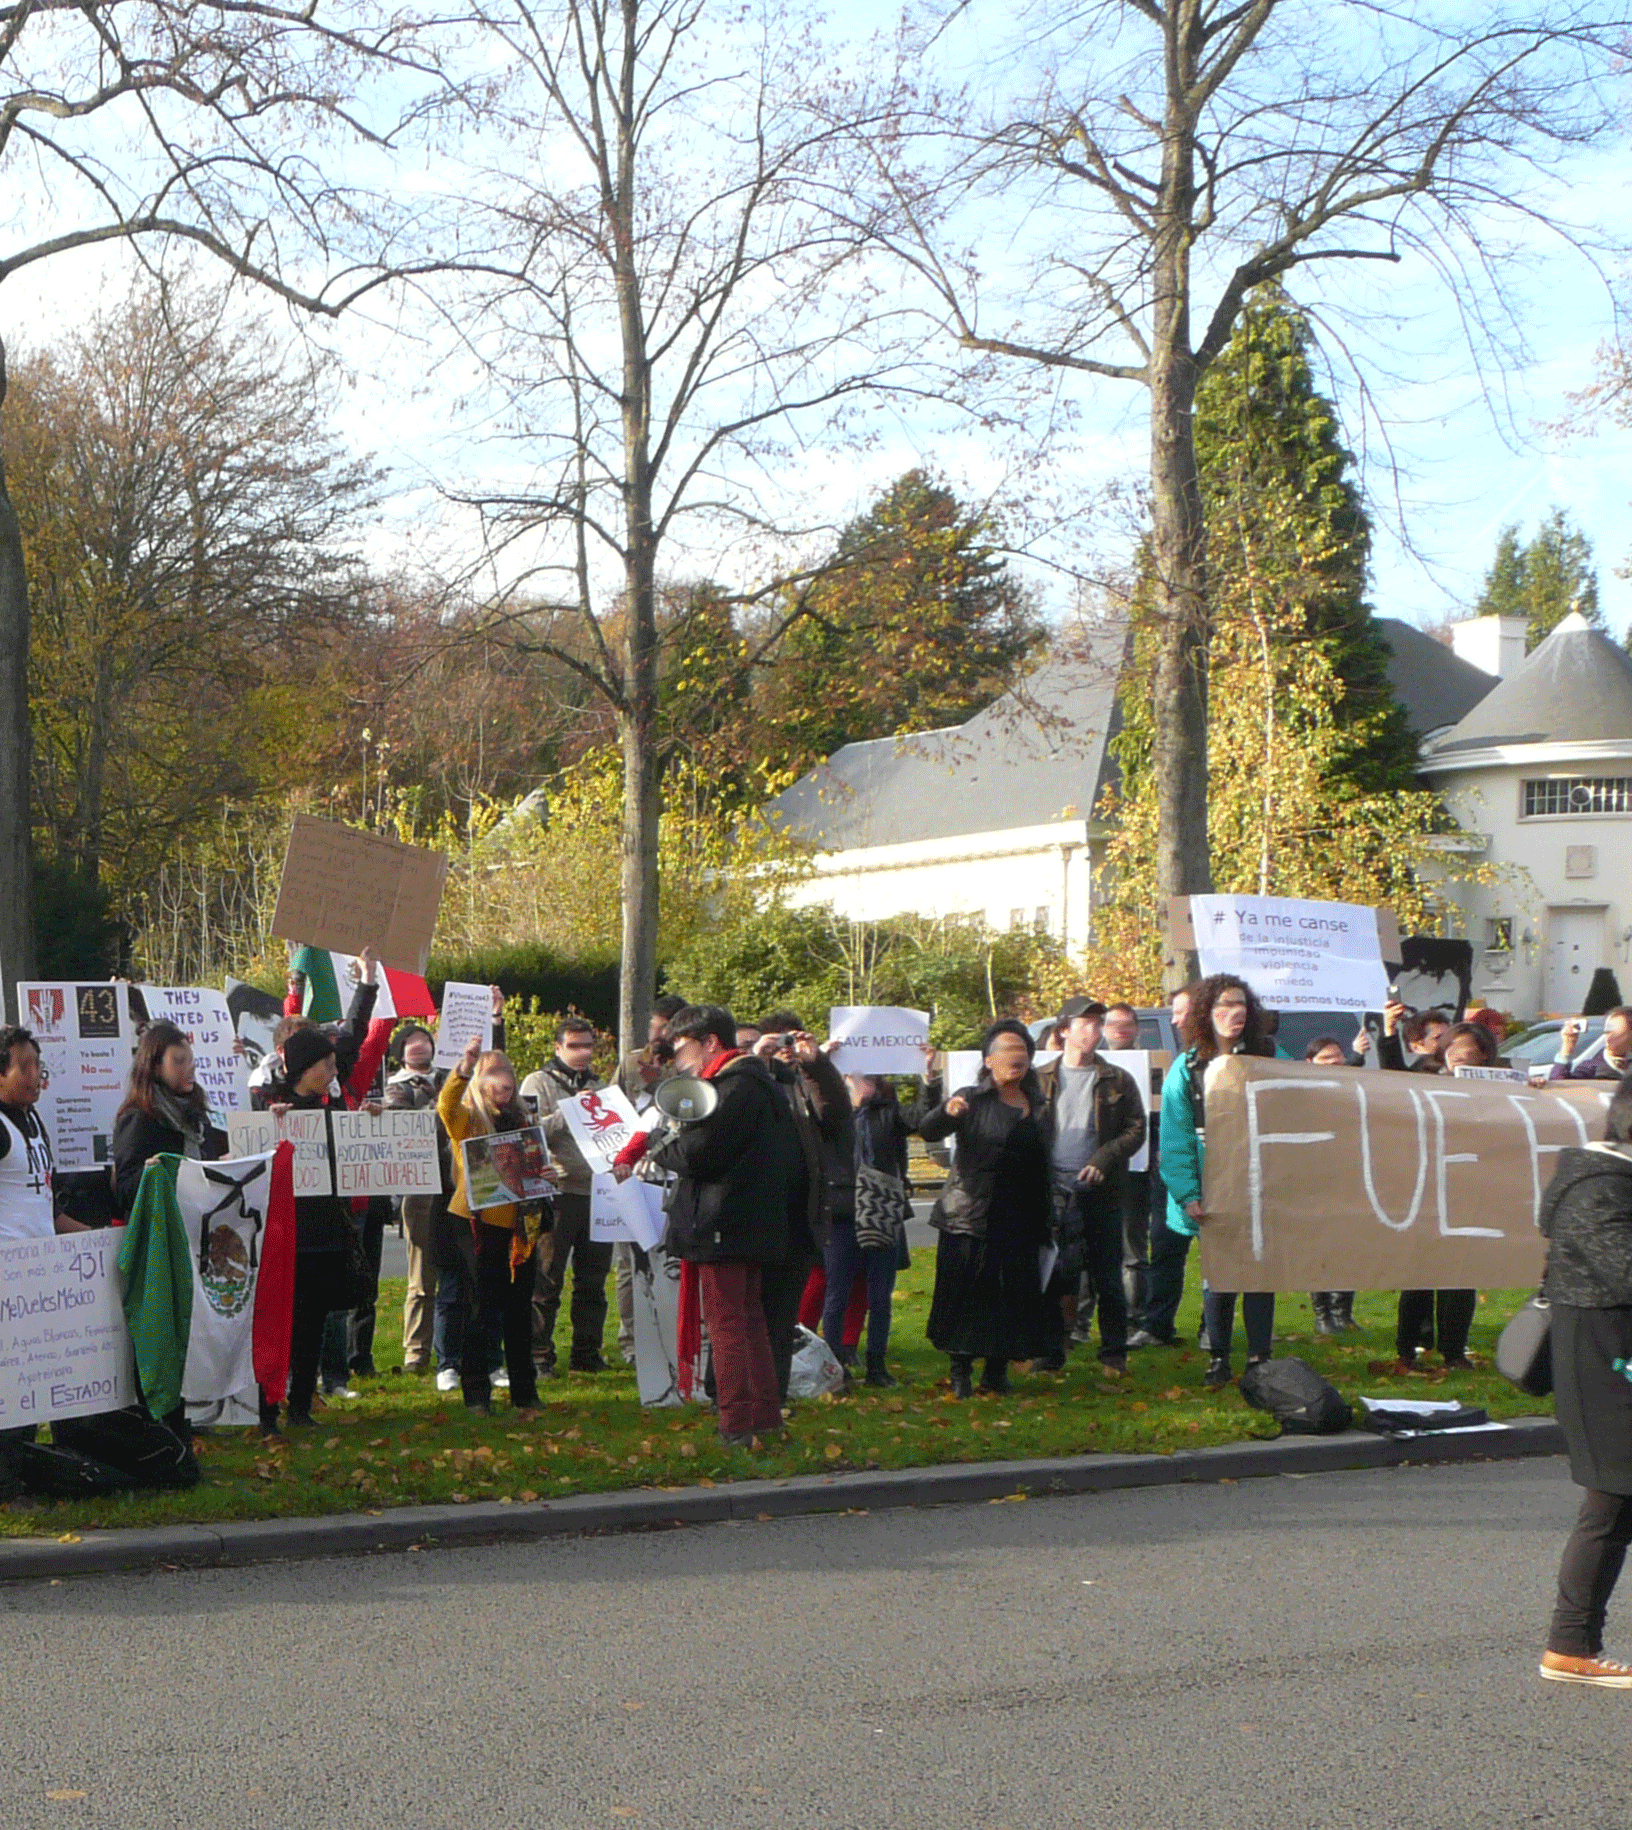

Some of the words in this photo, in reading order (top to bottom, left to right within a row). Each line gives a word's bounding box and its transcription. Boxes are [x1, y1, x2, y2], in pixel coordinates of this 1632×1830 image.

[1235, 909, 1258, 925] Ya
[1265, 914, 1292, 927] me
[1299, 917, 1349, 932] canse
[1239, 932, 1254, 942] de
[1257, 932, 1269, 943] la
[1274, 934, 1330, 948] injusticia
[1261, 960, 1319, 972] violencia
[1274, 977, 1314, 987] miedo
[164, 990, 200, 1005] THEY
[1294, 995, 1333, 1006] somos
[1335, 996, 1367, 1008] todos
[80, 988, 116, 1024] 43
[212, 1009, 229, 1023] TO
[201, 1030, 219, 1043] US
[872, 1034, 922, 1047] MEXICO
[81, 1064, 97, 1074] No
[194, 1056, 212, 1069] DID
[216, 1055, 240, 1067] NOT
[199, 1071, 235, 1086] THAT
[339, 1113, 366, 1139] FUE
[370, 1113, 388, 1139] EL
[337, 1141, 393, 1163] AYOTZINAPA
[341, 1162, 373, 1191] ETAT
[20, 1389, 37, 1410] el
